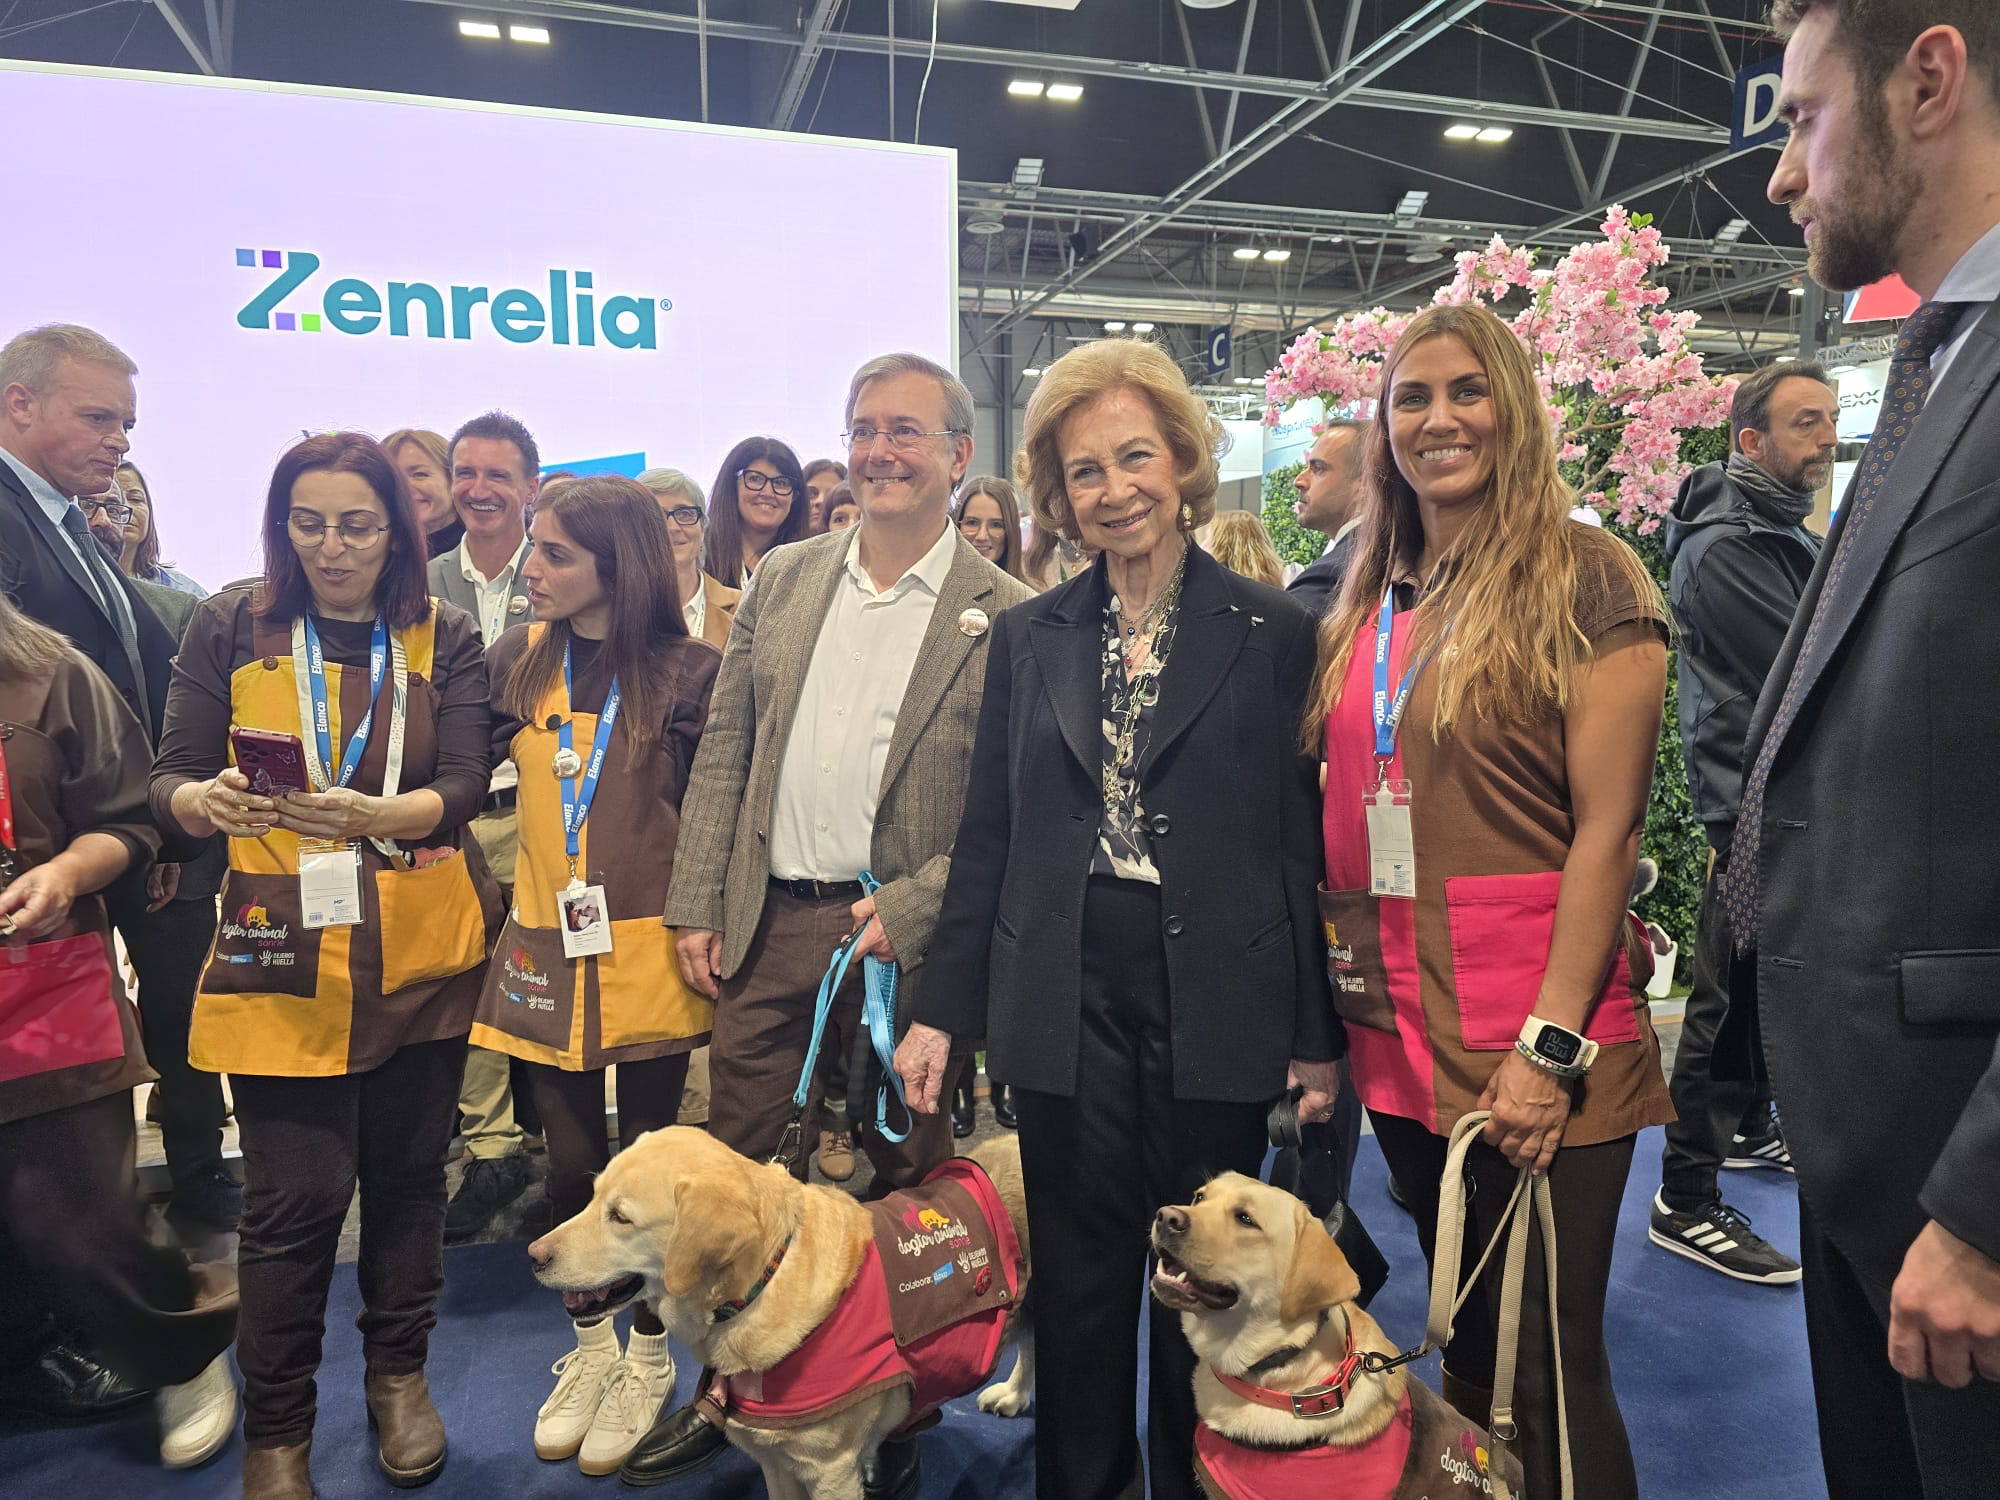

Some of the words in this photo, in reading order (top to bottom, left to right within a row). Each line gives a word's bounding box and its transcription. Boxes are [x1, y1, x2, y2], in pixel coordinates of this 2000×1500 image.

[1743, 73, 1782, 137] D
[1212, 332, 1226, 366] C
[1839, 389, 1880, 409] EXX
[311, 644, 323, 676] Elanco
[1376, 631, 1389, 664] Elanco
[372, 653, 383, 683] Elanco
[317, 701, 328, 733] Elanco
[603, 694, 620, 725] Elanco
[339, 764, 354, 788] anco
[587, 748, 603, 780] Elanco
[571, 804, 587, 834] Elanco
[247, 924, 289, 940] animal
[898, 1233, 935, 1257] dogtor
[933, 1218, 968, 1244] animal
[1440, 1446, 1481, 1488] dogtor
